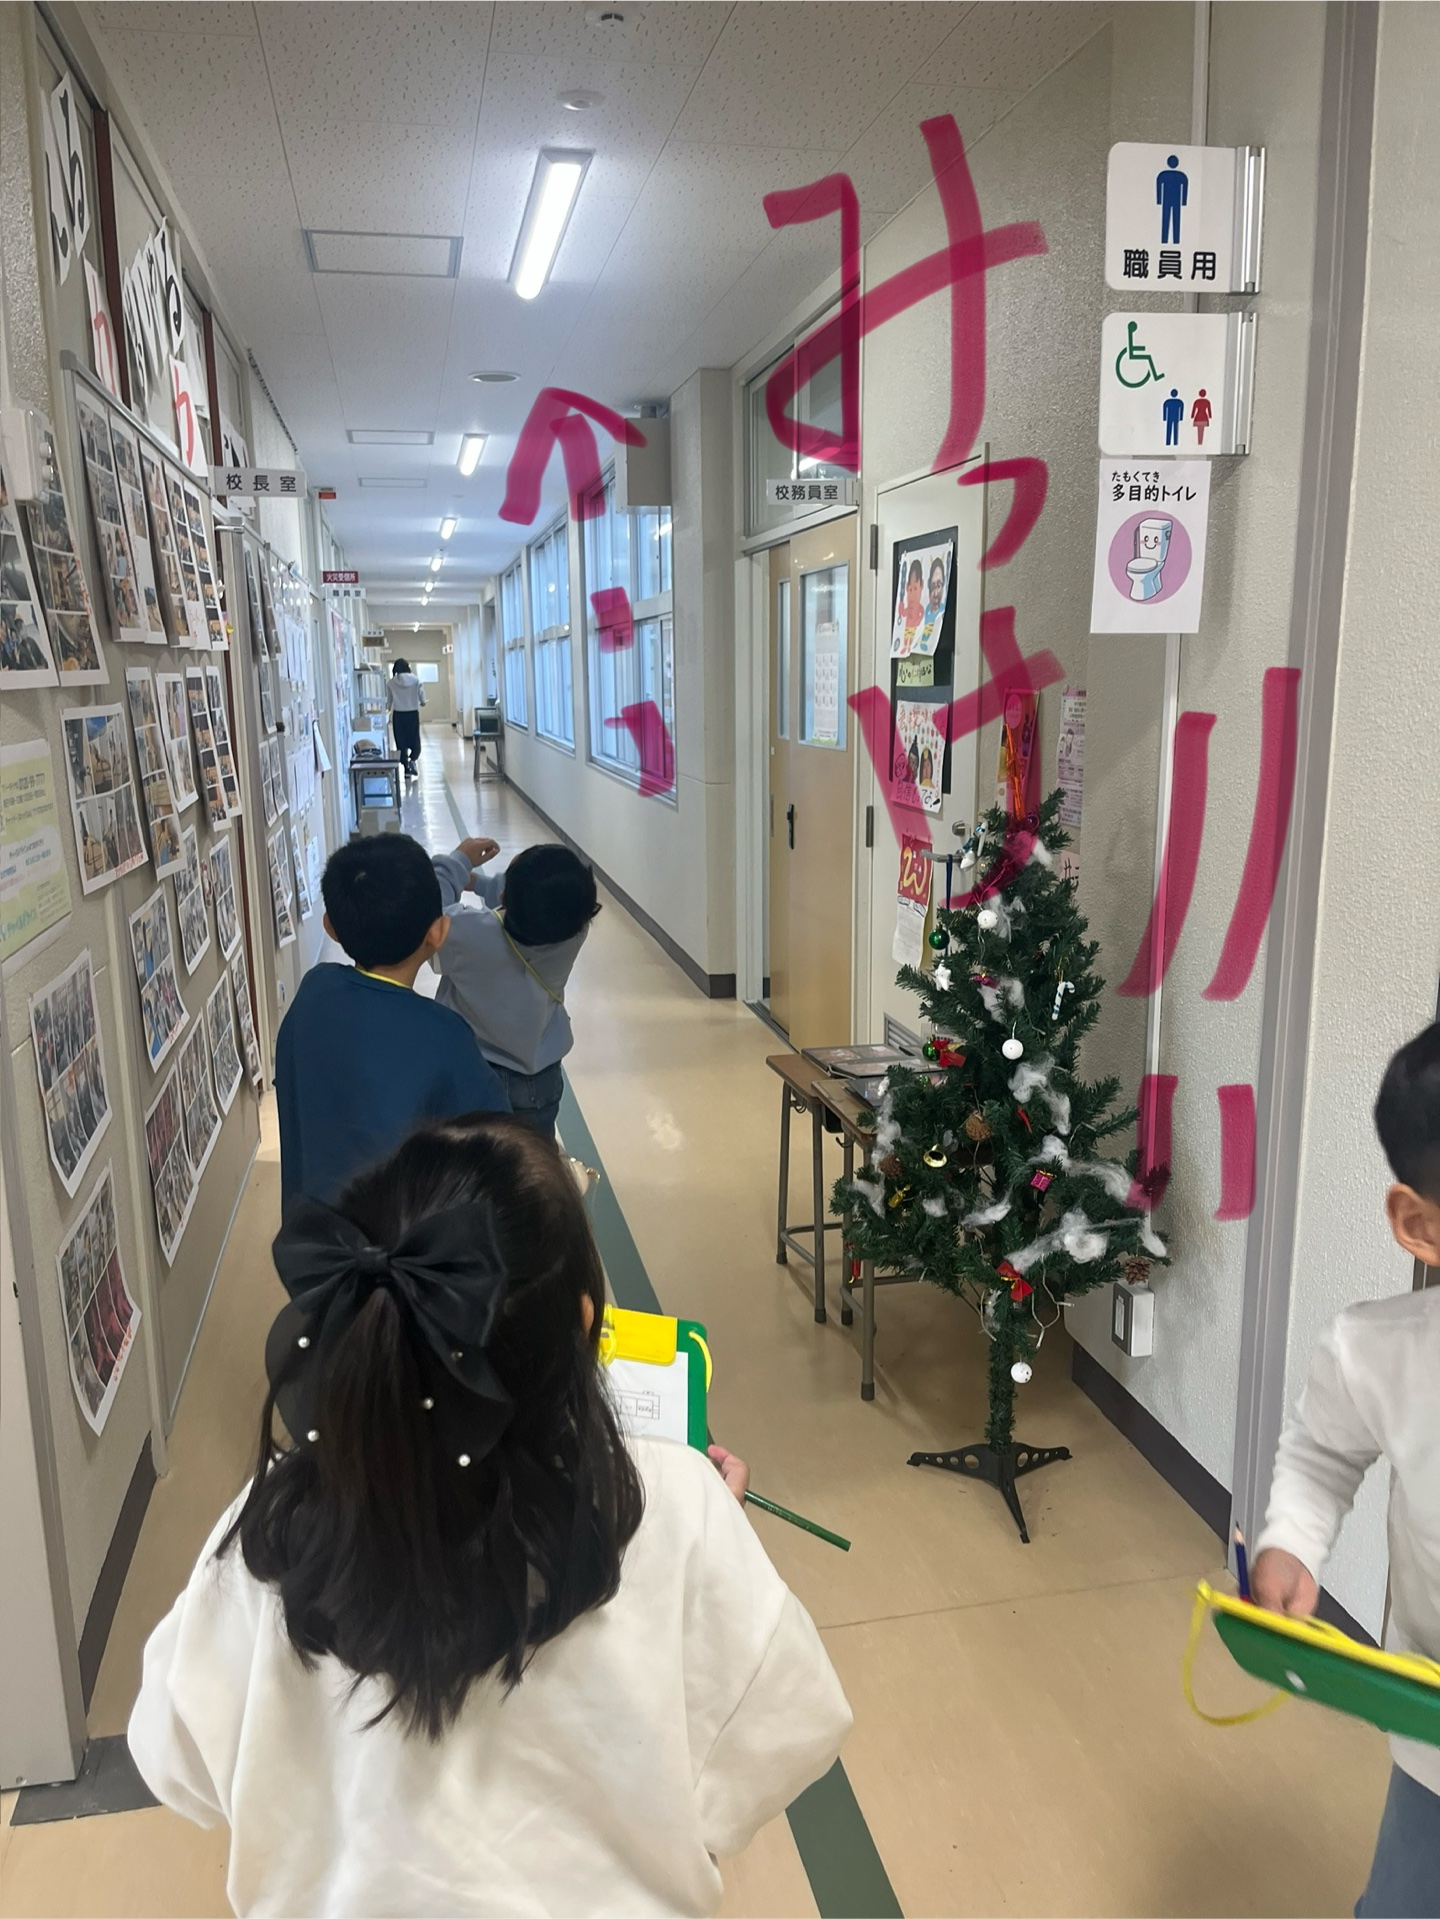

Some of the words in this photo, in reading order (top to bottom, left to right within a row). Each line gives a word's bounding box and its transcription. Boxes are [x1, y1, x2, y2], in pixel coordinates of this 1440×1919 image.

[1123, 249, 1216, 280] 職員用
[226, 474, 296, 492] 校長室
[1111, 471, 1160, 482] たもくてき
[775, 485, 838, 500] 校務員室
[1112, 484, 1197, 501] 多目的トイレ
